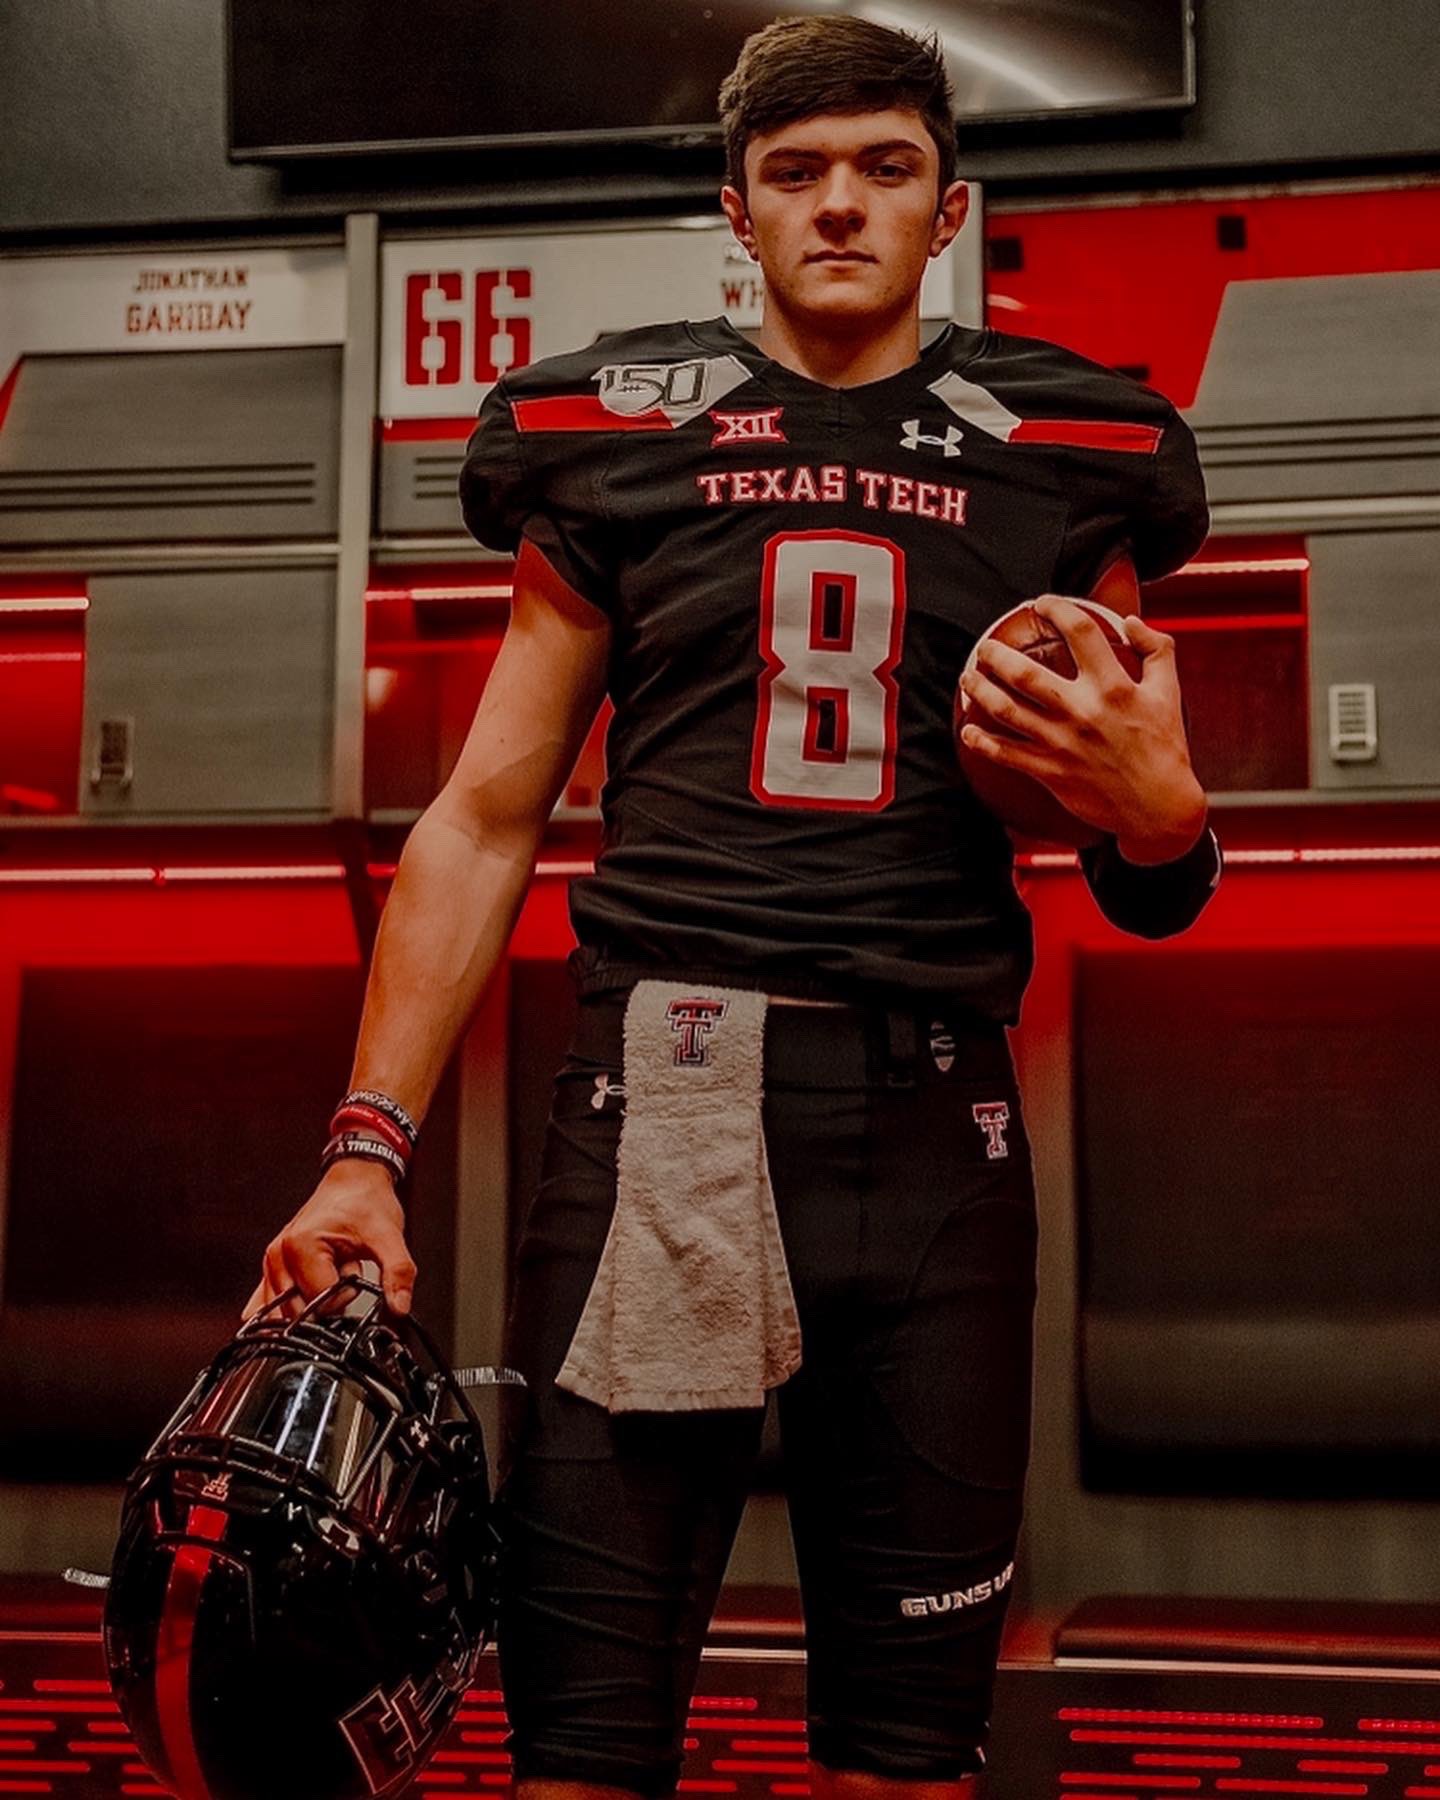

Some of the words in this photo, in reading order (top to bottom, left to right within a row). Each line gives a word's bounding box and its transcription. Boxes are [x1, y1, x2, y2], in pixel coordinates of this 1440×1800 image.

[405, 266, 533, 387] 66
[603, 361, 706, 414] 150
[714, 410, 785, 444] XII
[697, 466, 847, 505] TEXAS
[855, 469, 969, 527] TECH
[749, 528, 907, 812] 8
[900, 1580, 992, 1617] GUNS
